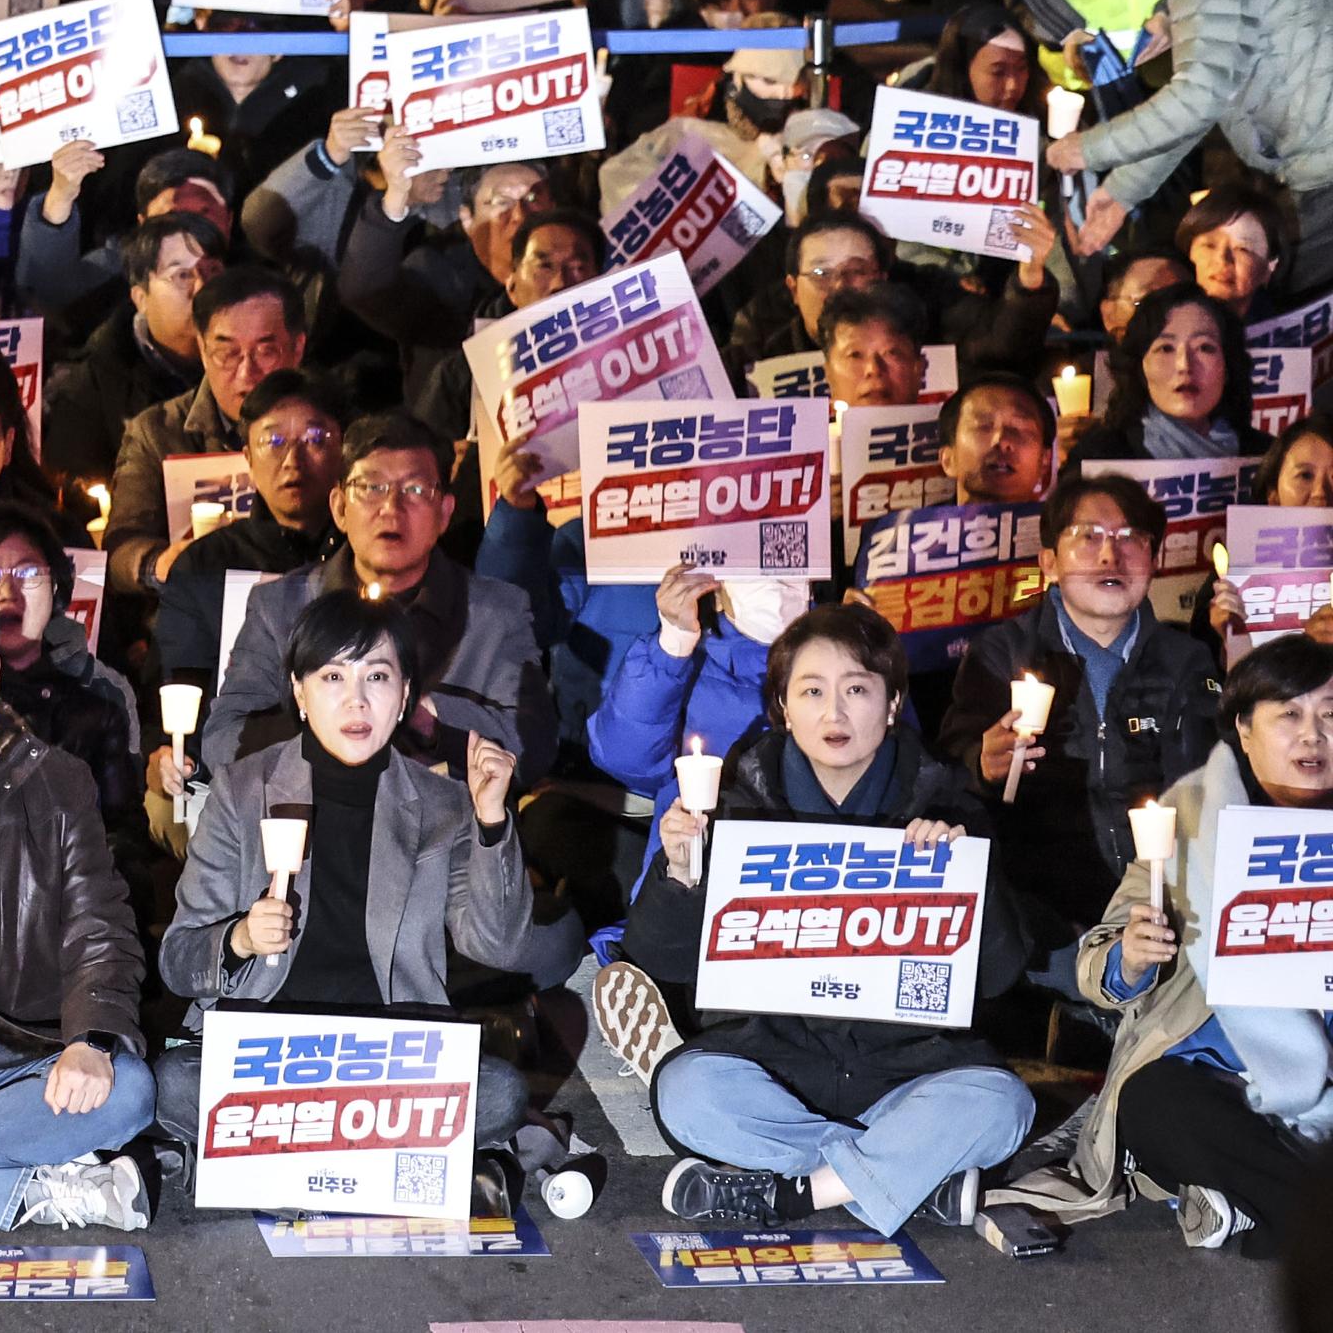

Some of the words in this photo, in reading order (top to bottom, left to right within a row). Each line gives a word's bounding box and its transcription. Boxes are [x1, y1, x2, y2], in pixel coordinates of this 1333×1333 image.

[411, 18, 562, 82] 국정농단
[403, 85, 494, 131] 윤석열
[494, 56, 583, 112] OUT!
[480, 134, 519, 152] 민주당
[893, 110, 1020, 157] 국정농단
[873, 159, 957, 198] 윤석열
[958, 166, 1030, 201] OUT!
[932, 219, 965, 237] 민주당
[496, 268, 659, 377] 국정농단
[501, 370, 603, 440] 윤석열
[600, 315, 696, 387] OUT!
[606, 406, 797, 469] 국정농단
[594, 477, 701, 531] 윤석열
[705, 464, 814, 518] OUT!
[679, 548, 728, 566] 민주당
[740, 842, 952, 891] 국정농단
[716, 906, 843, 952] 윤석열
[845, 906, 967, 946] OUT!
[810, 980, 861, 1000] 민주당
[233, 1030, 444, 1086] 국정농단
[213, 1104, 335, 1148] 윤석열
[339, 1096, 461, 1141] OUT!
[308, 1175, 358, 1194] 민주당
